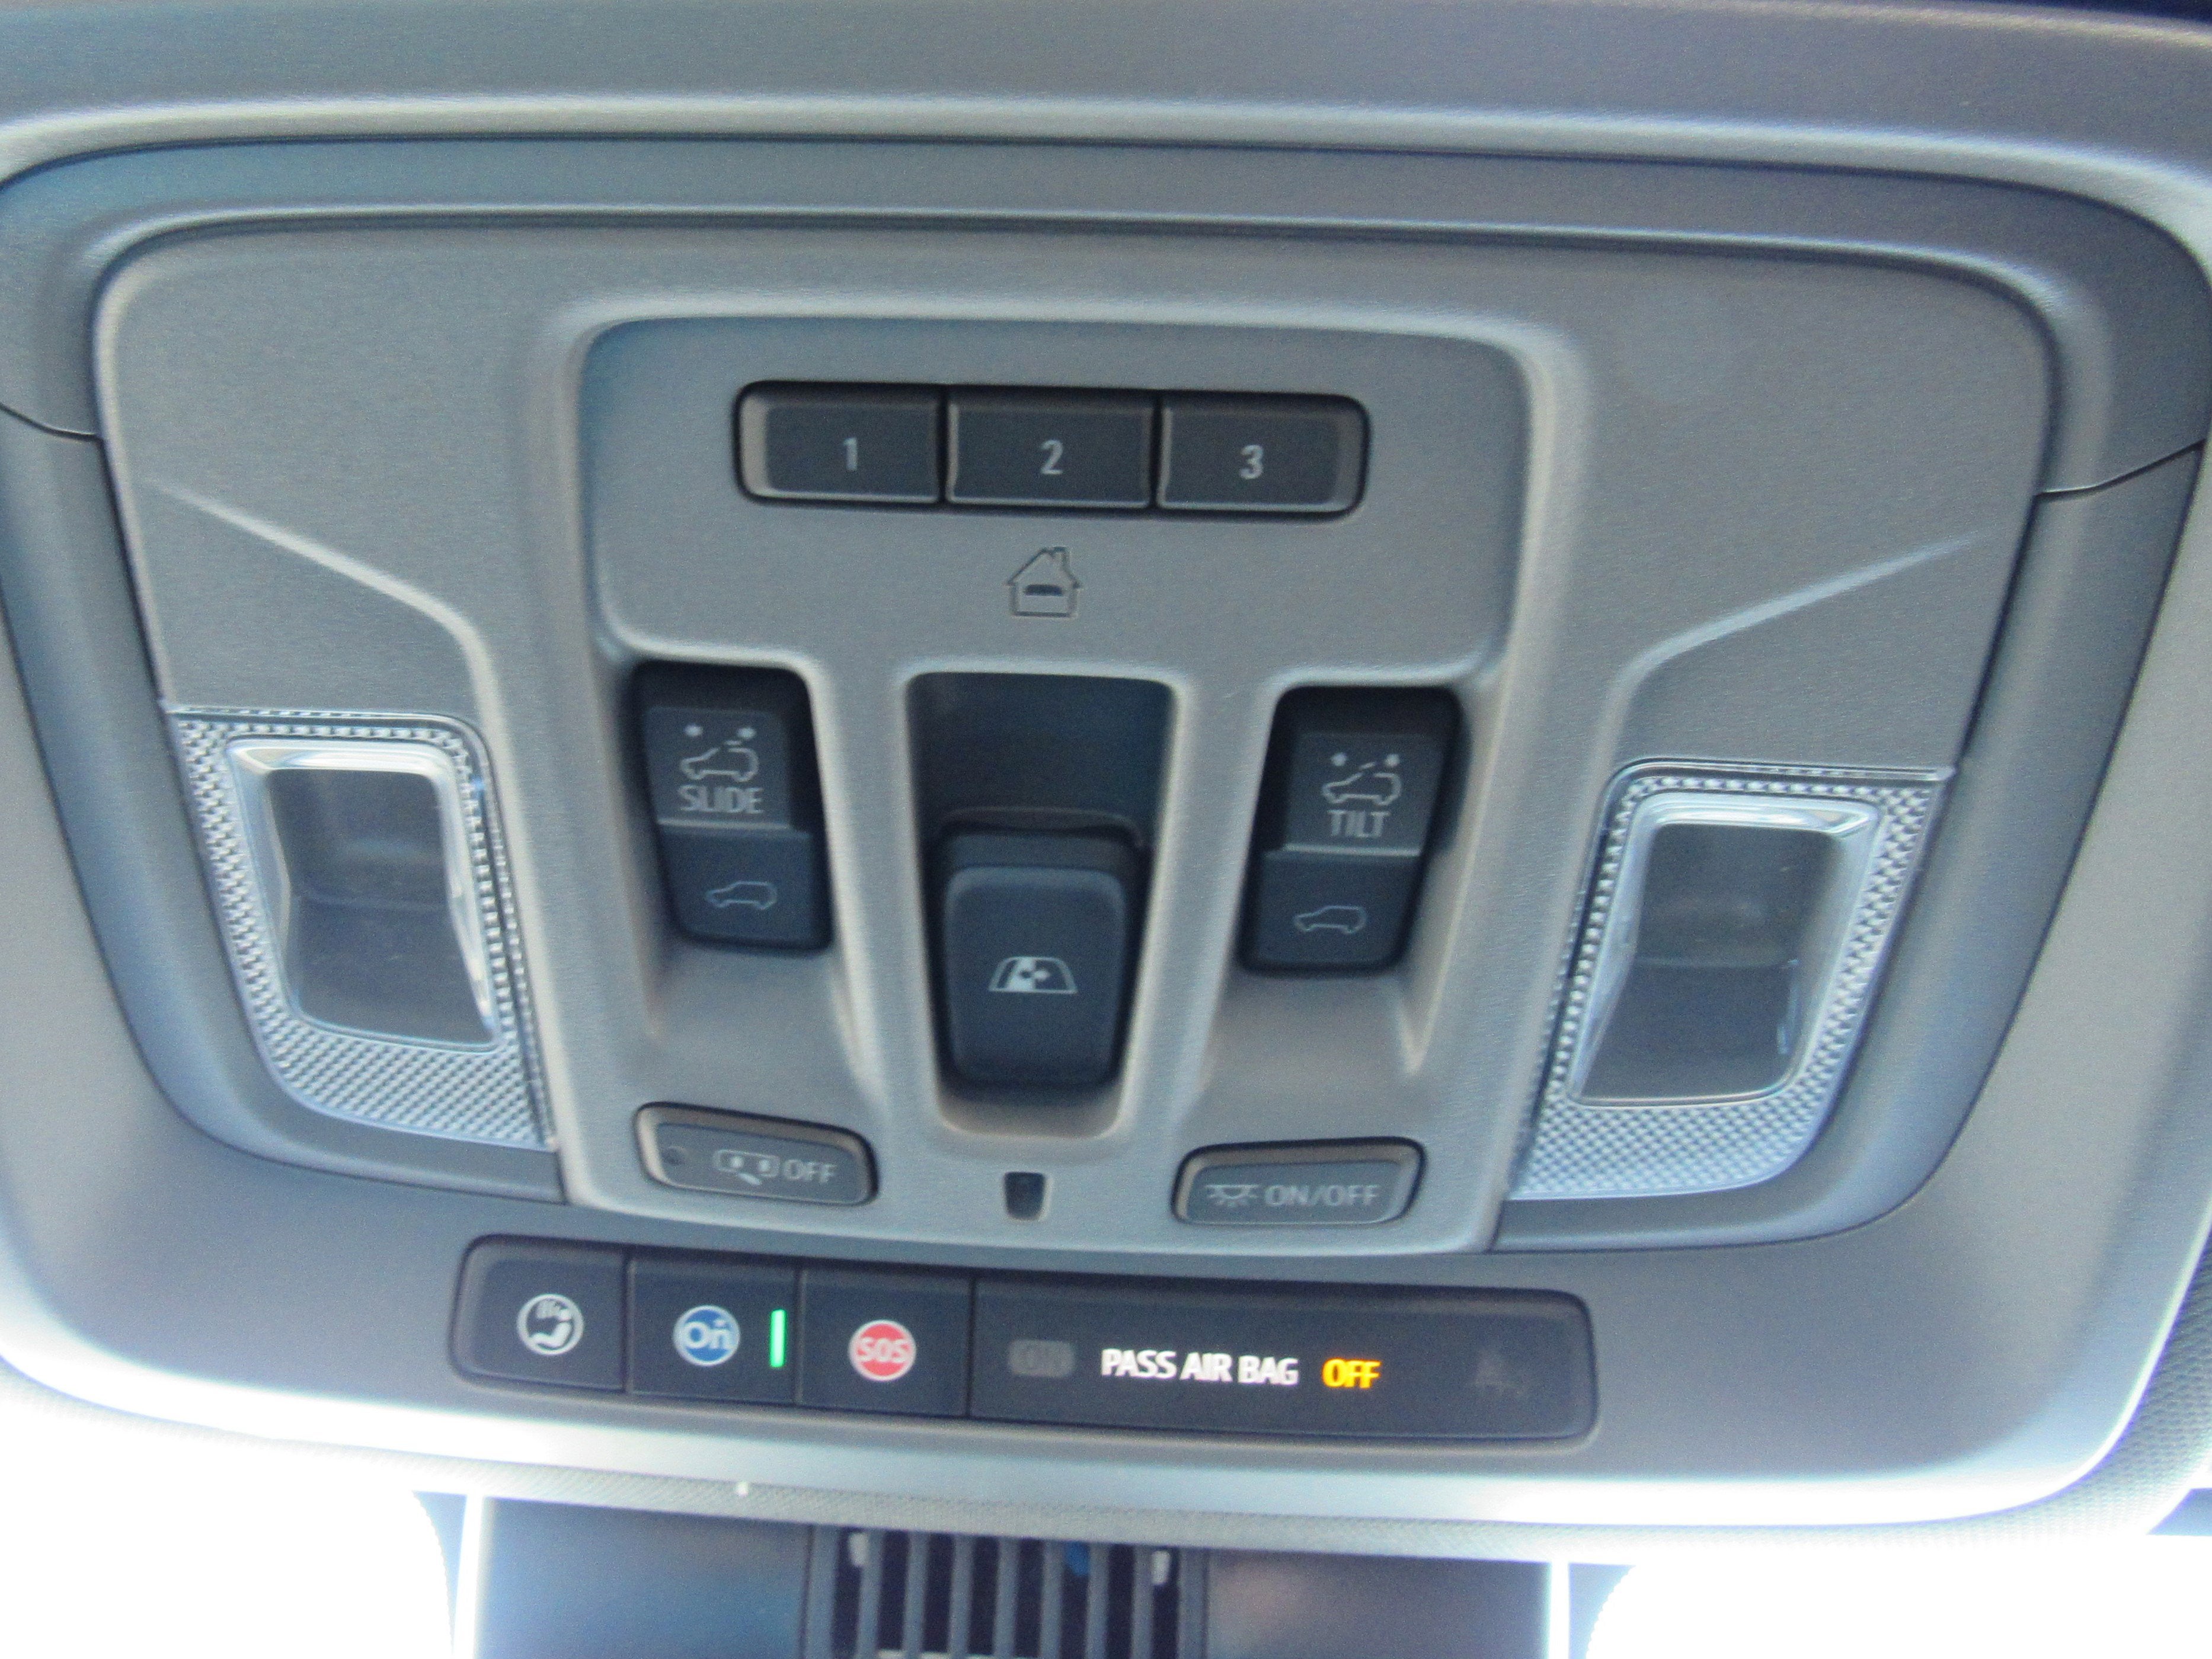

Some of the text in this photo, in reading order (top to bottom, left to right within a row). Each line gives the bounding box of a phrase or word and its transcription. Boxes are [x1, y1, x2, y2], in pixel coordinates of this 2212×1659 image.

[843, 437, 858, 471] 1
[1040, 439, 1063, 475] 2
[1240, 445, 1264, 479] 3
[677, 784, 765, 814] SLIDE
[1328, 810, 1391, 838] TILT
[782, 1159, 837, 1183] OFF
[1264, 1184, 1378, 1207] ON/OFF
[856, 1335, 909, 1364] SOS
[1101, 1348, 1381, 1389] PASS AIR BAG OFF
